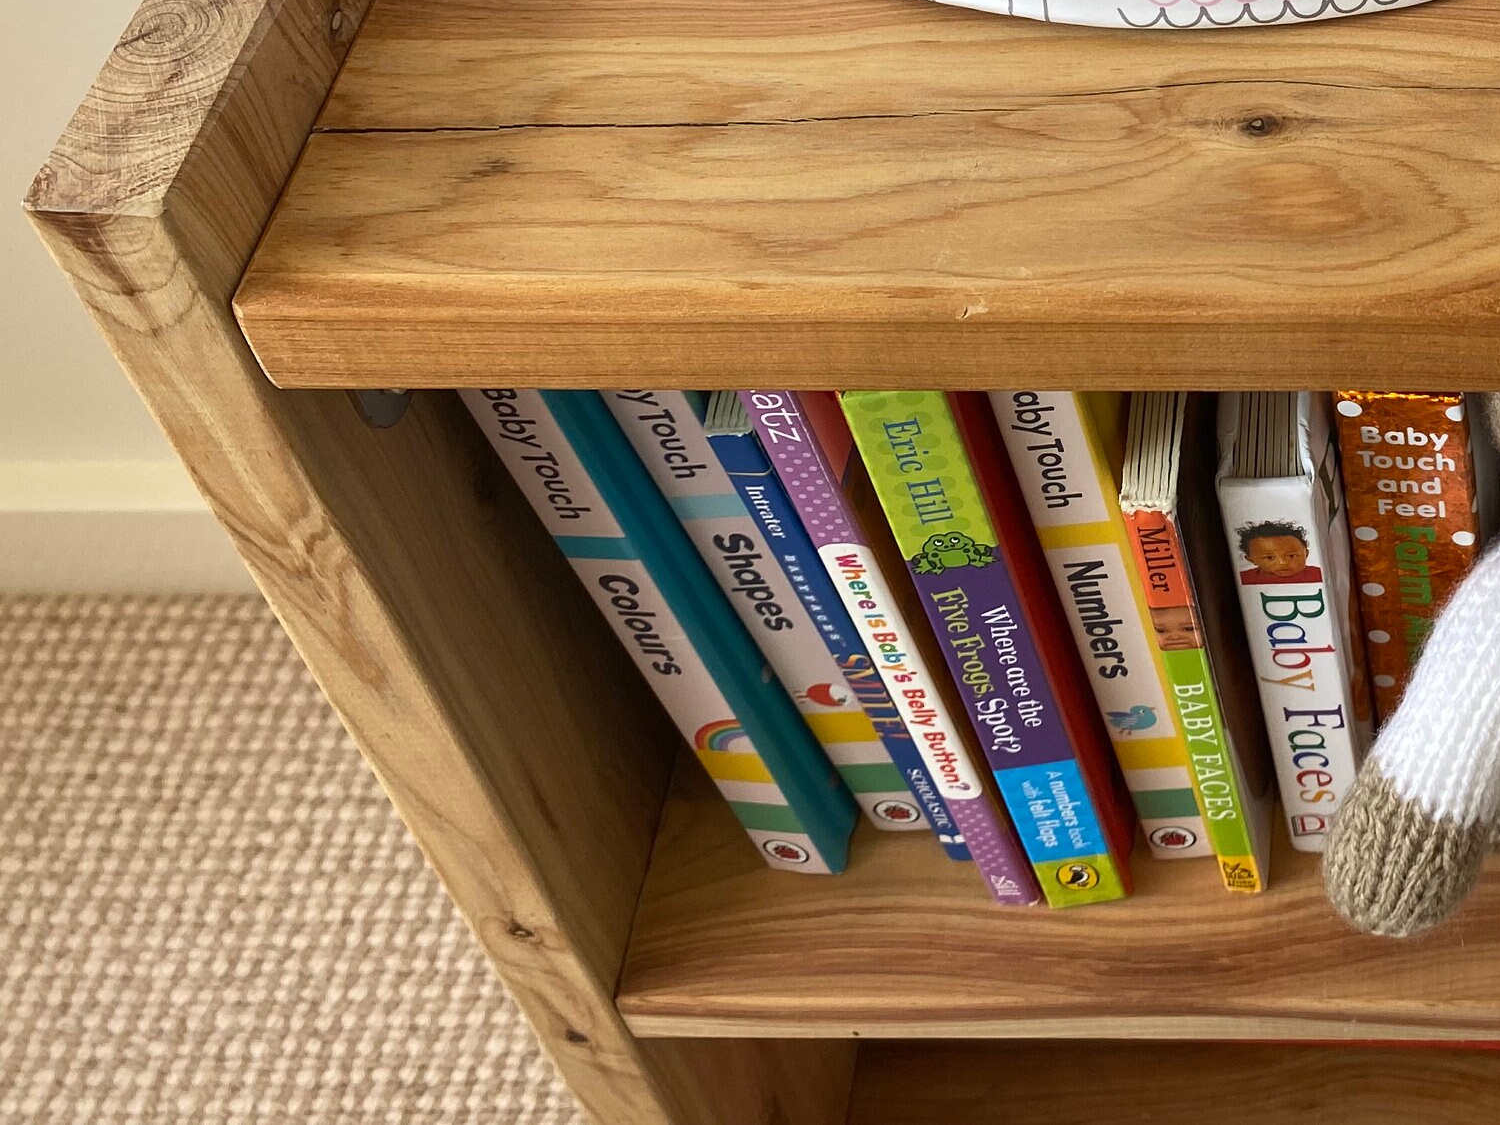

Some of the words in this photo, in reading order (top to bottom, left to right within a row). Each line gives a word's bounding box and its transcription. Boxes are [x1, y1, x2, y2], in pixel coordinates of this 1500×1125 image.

[750, 389, 801, 443] atz
[1011, 390, 1055, 436] aby
[1360, 426, 1449, 452] Baby
[480, 389, 542, 449] Baby
[521, 451, 591, 519] Touch
[638, 409, 707, 479] Touch
[883, 417, 926, 475] Eric
[907, 477, 954, 525] Hill
[1356, 450, 1456, 472] Touch
[1026, 438, 1082, 508] Touch
[1377, 477, 1442, 495] and
[744, 486, 785, 539] Intrater
[1378, 499, 1446, 518] Feel
[714, 532, 793, 632] Shapes
[834, 554, 876, 611] Where
[1137, 526, 1170, 593] Miller
[1392, 526, 1437, 605] Farm
[599, 574, 682, 676] Colours
[864, 613, 888, 628] Is
[981, 605, 1018, 665] Where
[1064, 560, 1128, 679] Numbers
[1260, 588, 1336, 692] Baby
[872, 632, 917, 683] Baby's
[930, 587, 969, 633] Five
[950, 633, 994, 698] Frogs,
[974, 698, 1022, 753] Spot?
[1006, 667, 1031, 697] are
[902, 688, 935, 727] Belly
[1017, 699, 1044, 727] the
[1173, 681, 1218, 746] BABY
[923, 732, 970, 791] Button?
[1045, 771, 1063, 780] A
[1283, 704, 1345, 803] Faces
[907, 768, 952, 829] SCHOLASTIC
[1021, 780, 1044, 799] with
[1028, 798, 1056, 818] felt
[1049, 780, 1081, 827] numbers
[1192, 752, 1237, 820] FACES
[1036, 819, 1062, 848] flaps
[1068, 826, 1091, 851] book
